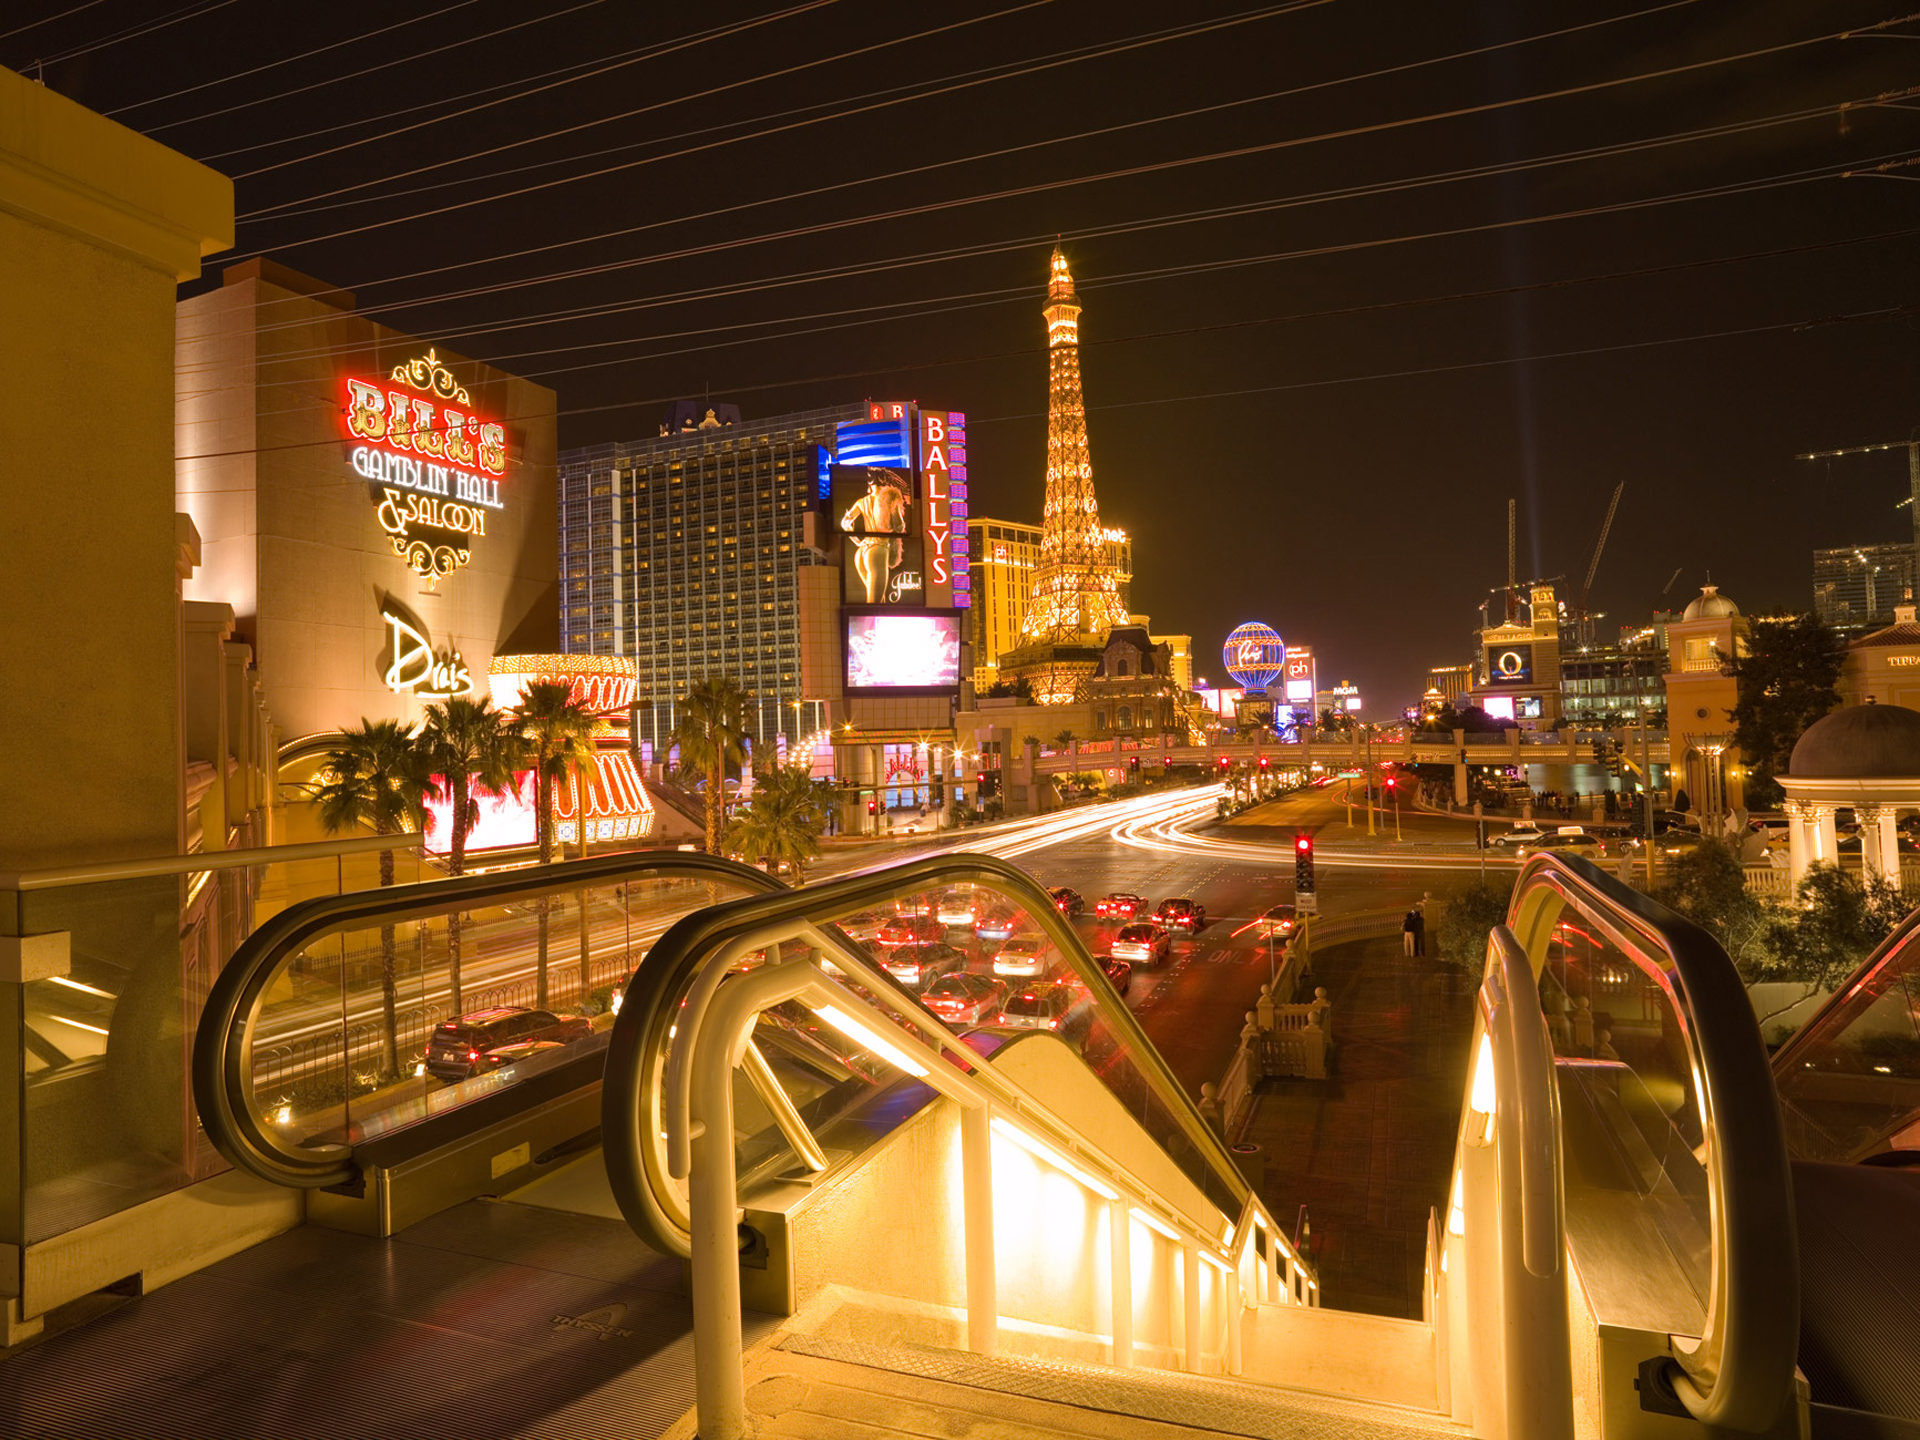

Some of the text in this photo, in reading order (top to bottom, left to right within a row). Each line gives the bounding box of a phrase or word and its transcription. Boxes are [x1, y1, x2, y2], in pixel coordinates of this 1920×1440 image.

[347, 378, 506, 476] BILL'S
[352, 446, 504, 509] GAMBLIN' HALL
[926, 416, 949, 584] BALLYS
[377, 487, 486, 536] & SALOON
[1333, 686, 1358, 696] MGM
[1499, 651, 1522, 676] O
